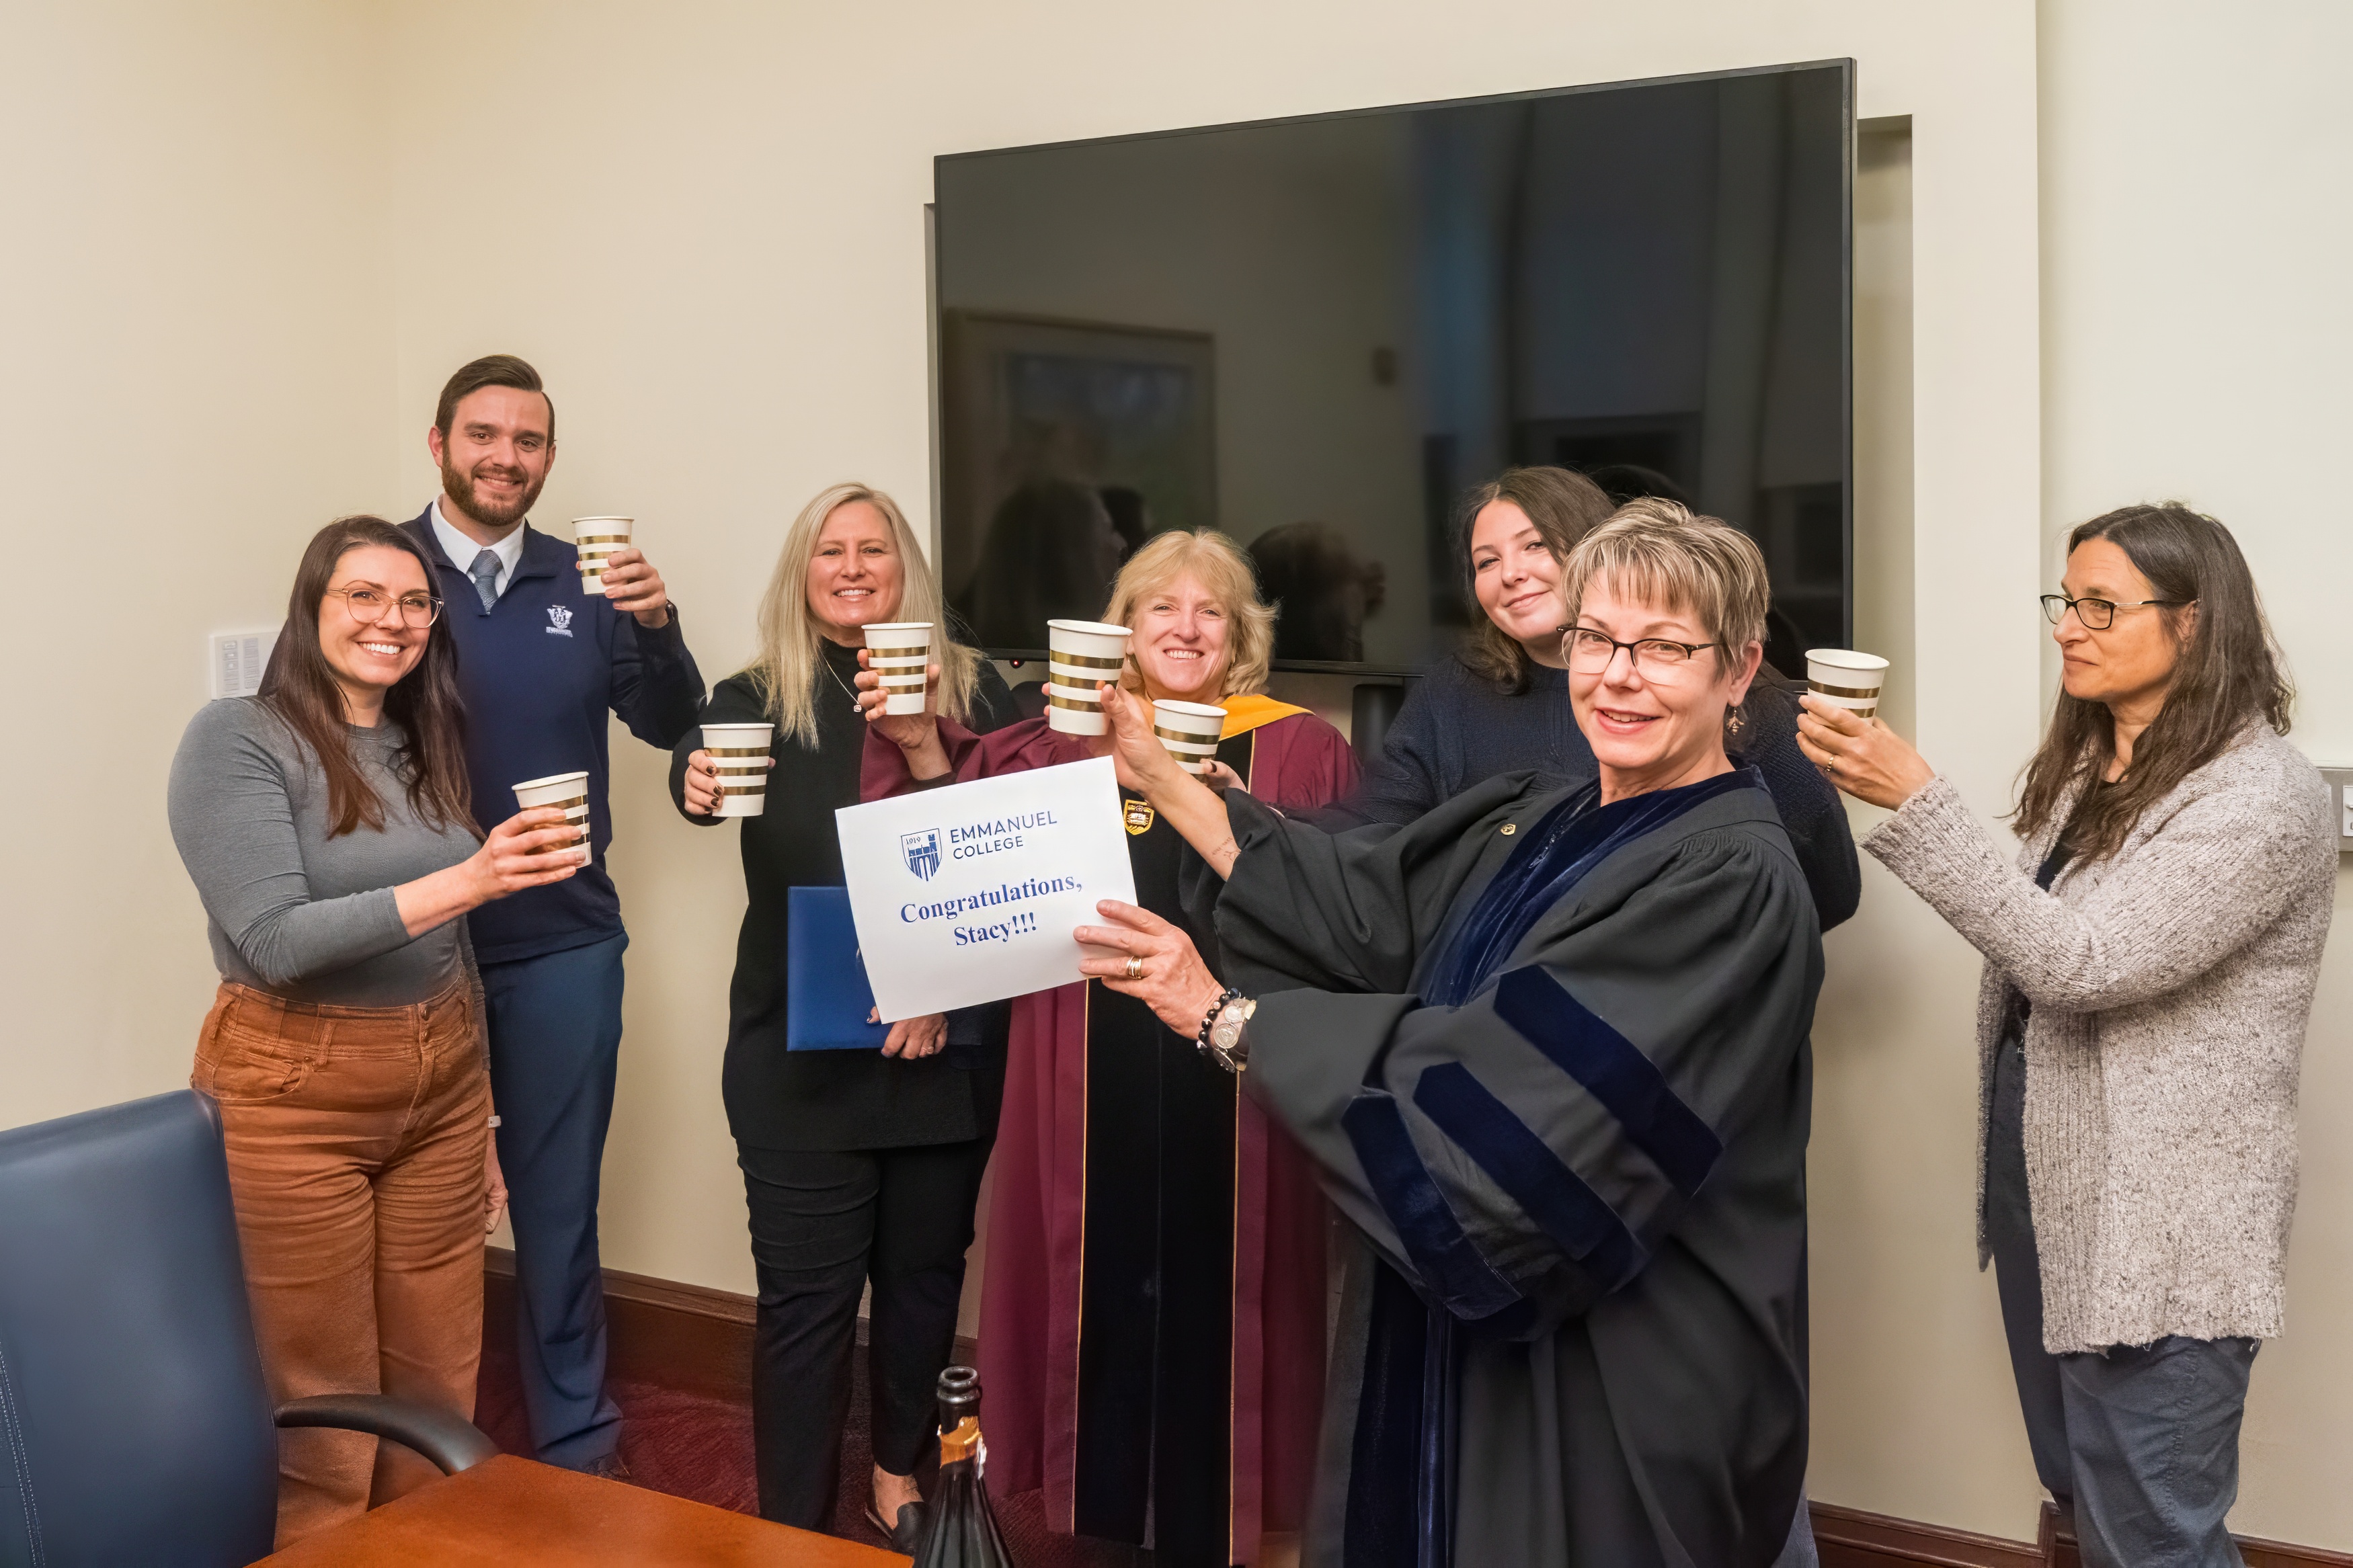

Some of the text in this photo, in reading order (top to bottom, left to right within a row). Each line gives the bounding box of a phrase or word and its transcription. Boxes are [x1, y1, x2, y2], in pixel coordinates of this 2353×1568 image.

[950, 811, 1058, 843] EMMANUEL
[953, 835, 1024, 860] COLLEGE
[900, 876, 1082, 923] Congratulations,
[953, 911, 1037, 946] Stacy!!!
